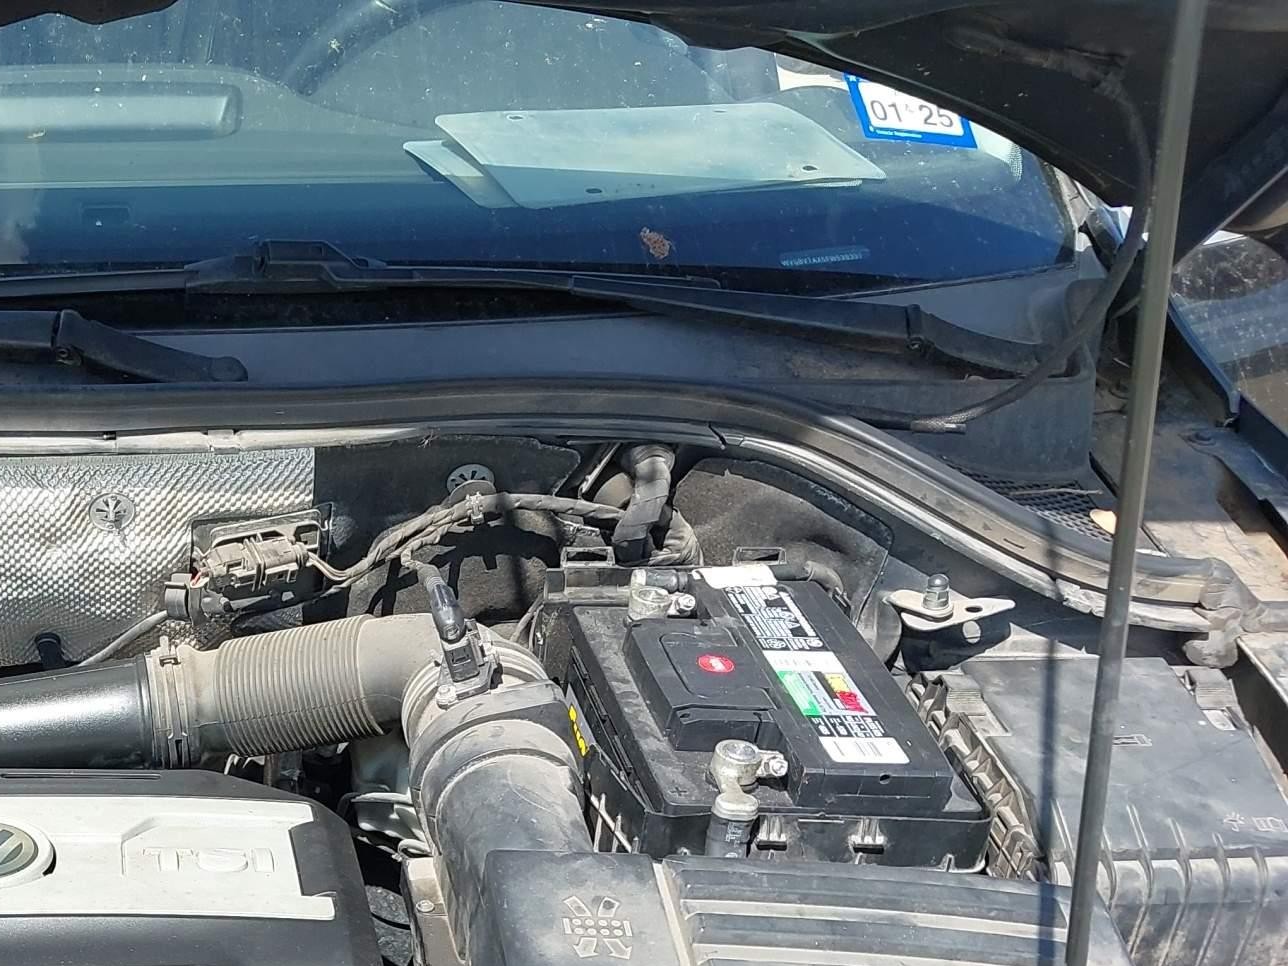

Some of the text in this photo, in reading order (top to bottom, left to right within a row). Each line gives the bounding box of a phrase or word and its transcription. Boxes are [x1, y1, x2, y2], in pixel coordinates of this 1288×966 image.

[869, 100, 954, 128] 01 25
[143, 847, 275, 873] TSI
